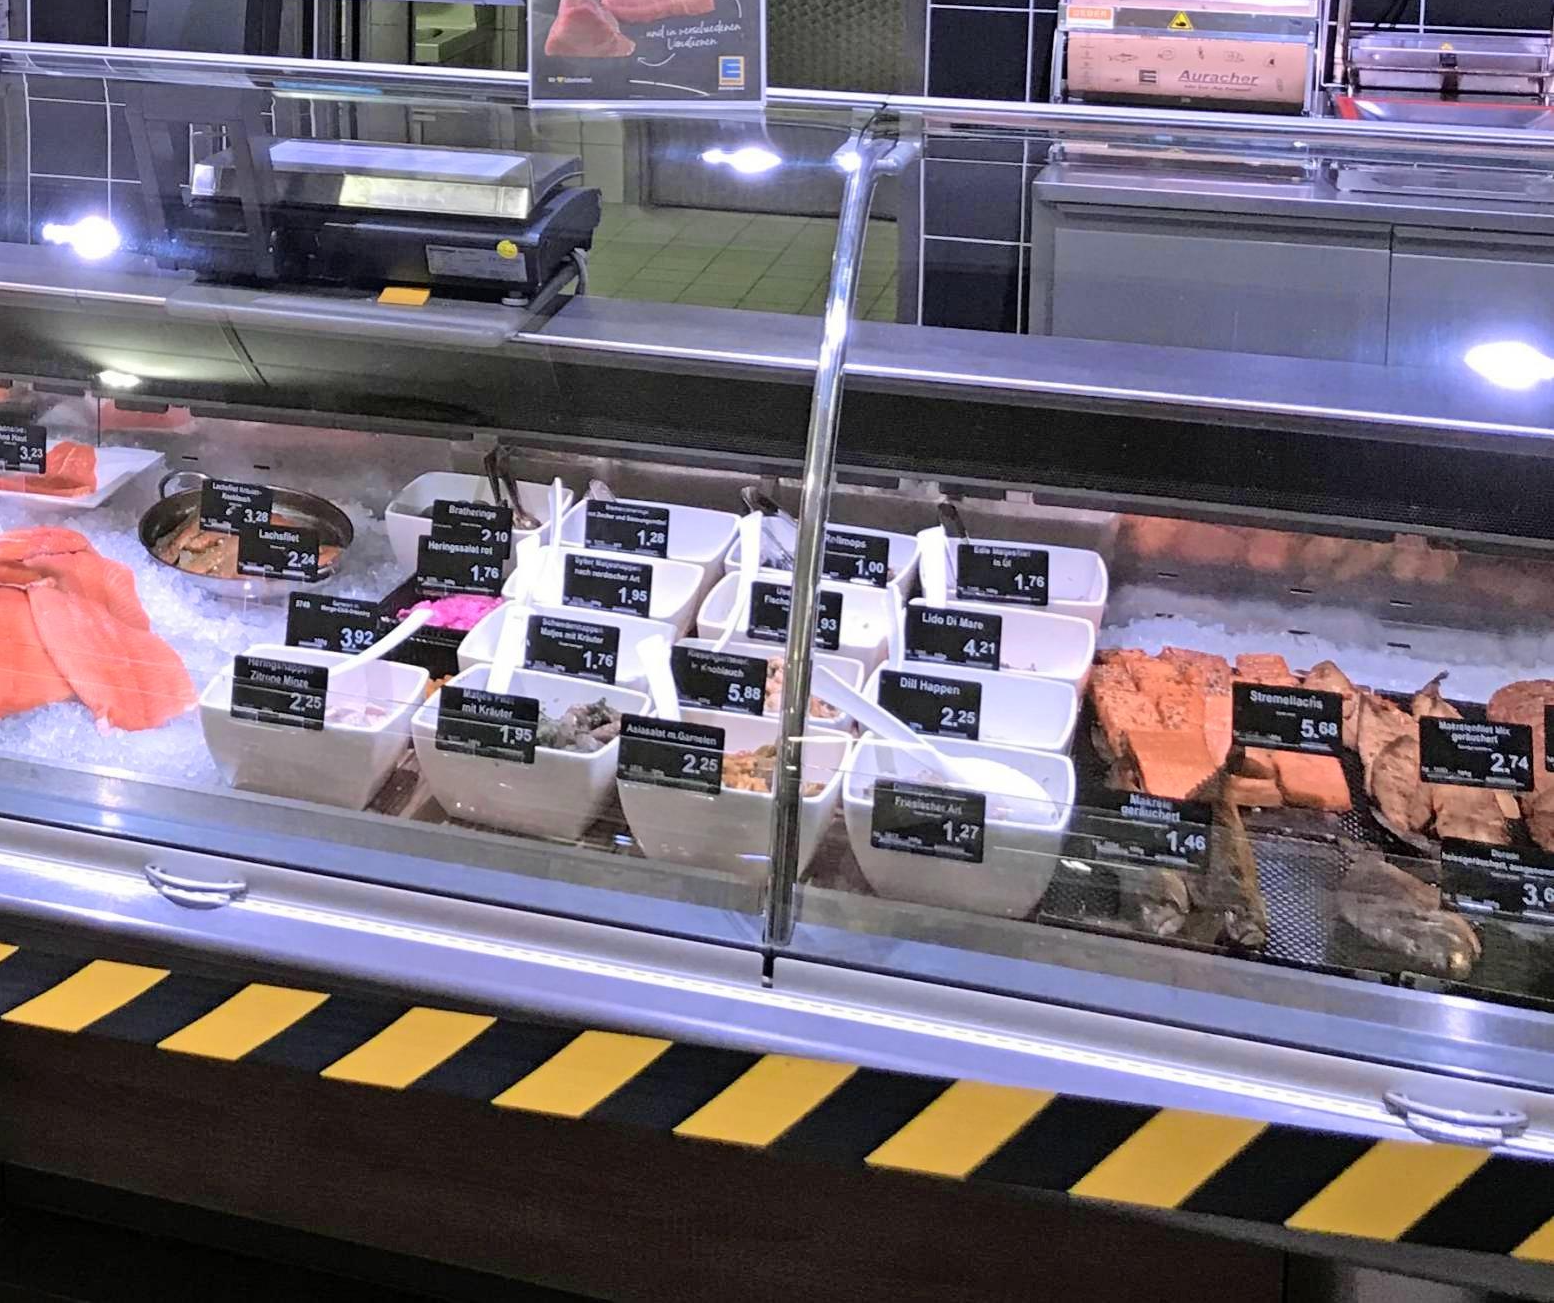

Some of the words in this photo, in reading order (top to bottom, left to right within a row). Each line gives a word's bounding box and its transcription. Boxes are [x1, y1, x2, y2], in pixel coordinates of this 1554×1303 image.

[1178, 70, 1259, 85] Auracher
[20, 446, 43, 460] 3.23
[244, 509, 268, 523] 3.28
[449, 505, 497, 520] Bratheringe
[259, 529, 299, 543] Lachsfilet
[637, 530, 665, 546] 1.28
[428, 541, 479, 554] Heringssalat
[481, 546, 493, 555] rot
[288, 550, 315, 567] 2.24
[855, 559, 884, 576] 1.00
[470, 565, 499, 582] 1.76
[1014, 573, 1045, 591] 1.76
[619, 587, 647, 604] 1.95
[922, 612, 944, 624] Lido
[947, 615, 957, 626] Di
[959, 617, 984, 630] Mare
[340, 628, 373, 648] 3.92
[541, 627, 563, 639] Matjes
[564, 630, 576, 640] mit
[577, 632, 604, 644] Kräuter
[963, 639, 995, 657] 4.21
[583, 651, 613, 669] 1.76
[250, 670, 281, 684] Zitrone
[284, 675, 309, 688] Minze
[900, 677, 917, 689] Dill
[920, 680, 961, 695] Happen
[289, 692, 322, 711] 2.25
[728, 683, 761, 702] 5.88
[1250, 690, 1323, 710] Stremellachs
[462, 704, 477, 713] mit
[478, 704, 513, 718] Kräuter
[940, 707, 975, 727] 2.25
[499, 725, 532, 744] 1.95
[626, 724, 666, 738] Asiasalat
[1301, 718, 1338, 738] 5.68
[682, 753, 718, 774] 2.25
[1490, 753, 1528, 774] 2.74
[895, 796, 946, 812] Friesischer
[948, 804, 962, 815] Art
[1121, 805, 1181, 822] geräuchert
[943, 820, 979, 842] 1.27
[1166, 830, 1206, 853] 1.46
